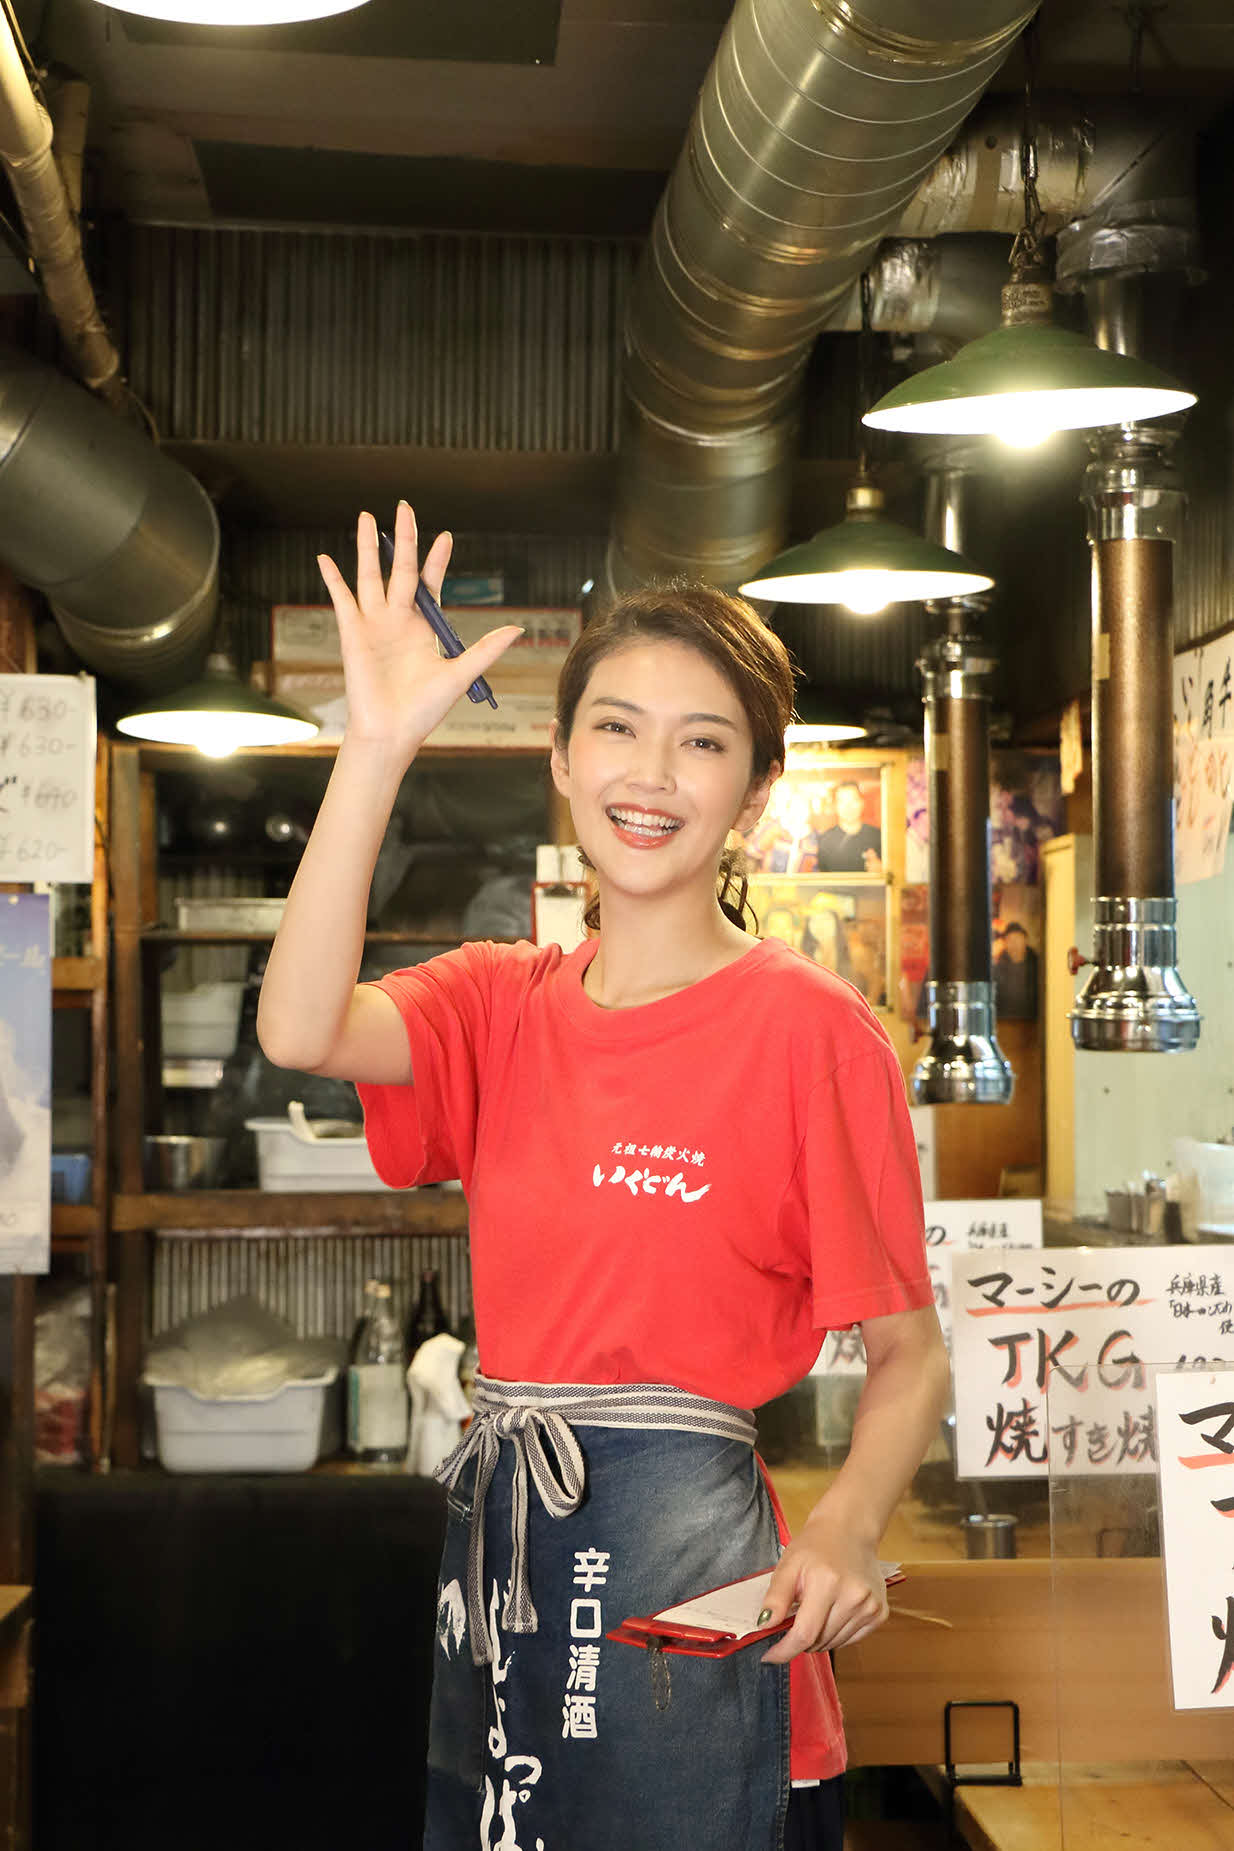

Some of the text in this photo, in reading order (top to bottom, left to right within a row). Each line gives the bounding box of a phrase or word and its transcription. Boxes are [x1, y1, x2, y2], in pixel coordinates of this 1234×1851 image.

[611, 1142, 706, 1168] 元祖七輪炭火焼
[592, 1163, 712, 1203] いくどん
[966, 1265, 1141, 1309] マーシーの
[562, 1546, 611, 1739] 辛口清酒
